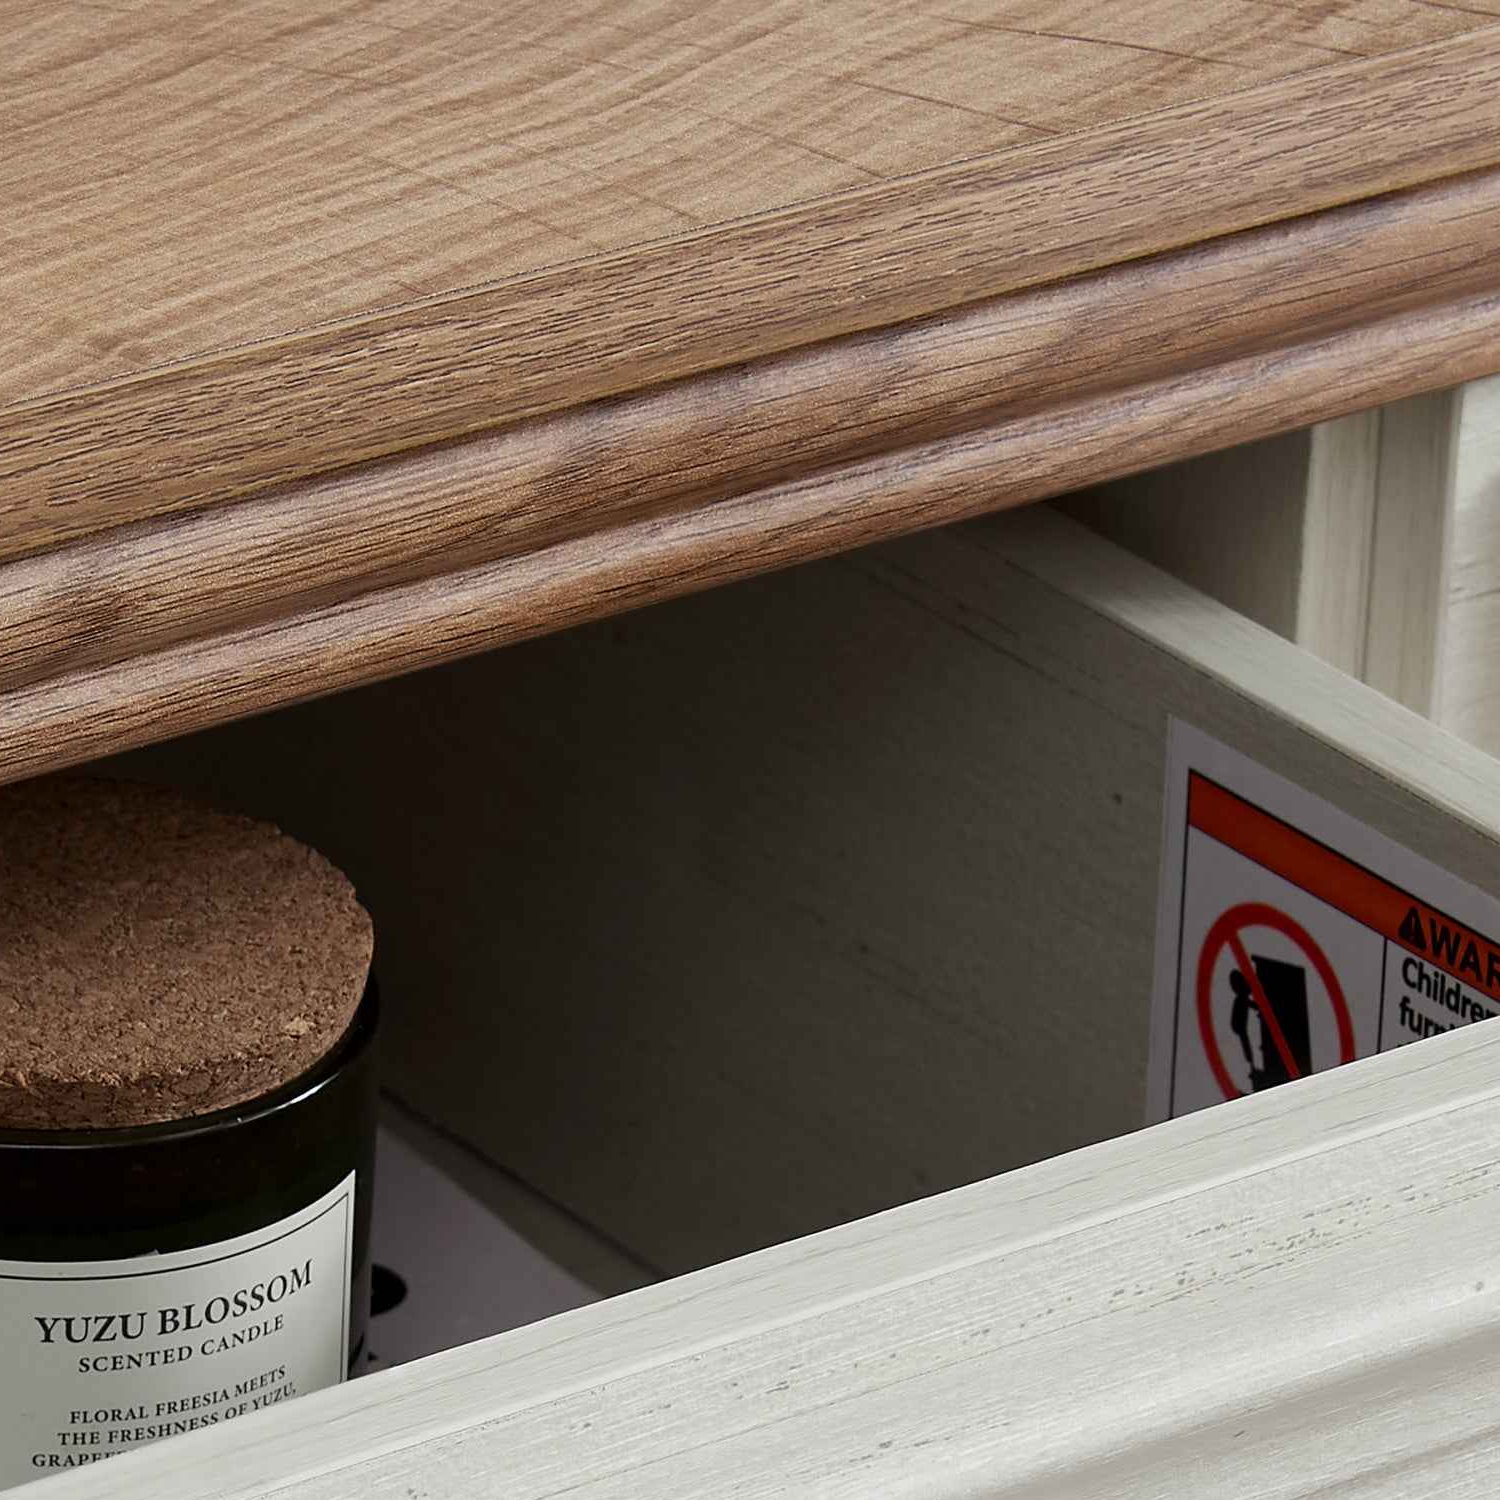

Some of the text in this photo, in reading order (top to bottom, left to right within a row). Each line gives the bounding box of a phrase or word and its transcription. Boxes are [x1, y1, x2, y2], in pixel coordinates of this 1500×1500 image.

[34, 1311, 148, 1344] YUZU
[156, 1257, 313, 1336] BLOSSOM
[78, 1313, 285, 1373] SCENTED CANDLE
[57, 1381, 297, 1446] THE FRESHNESS OF YUZU,
[69, 1364, 286, 1425] FLORAL FREESIA MEETS
